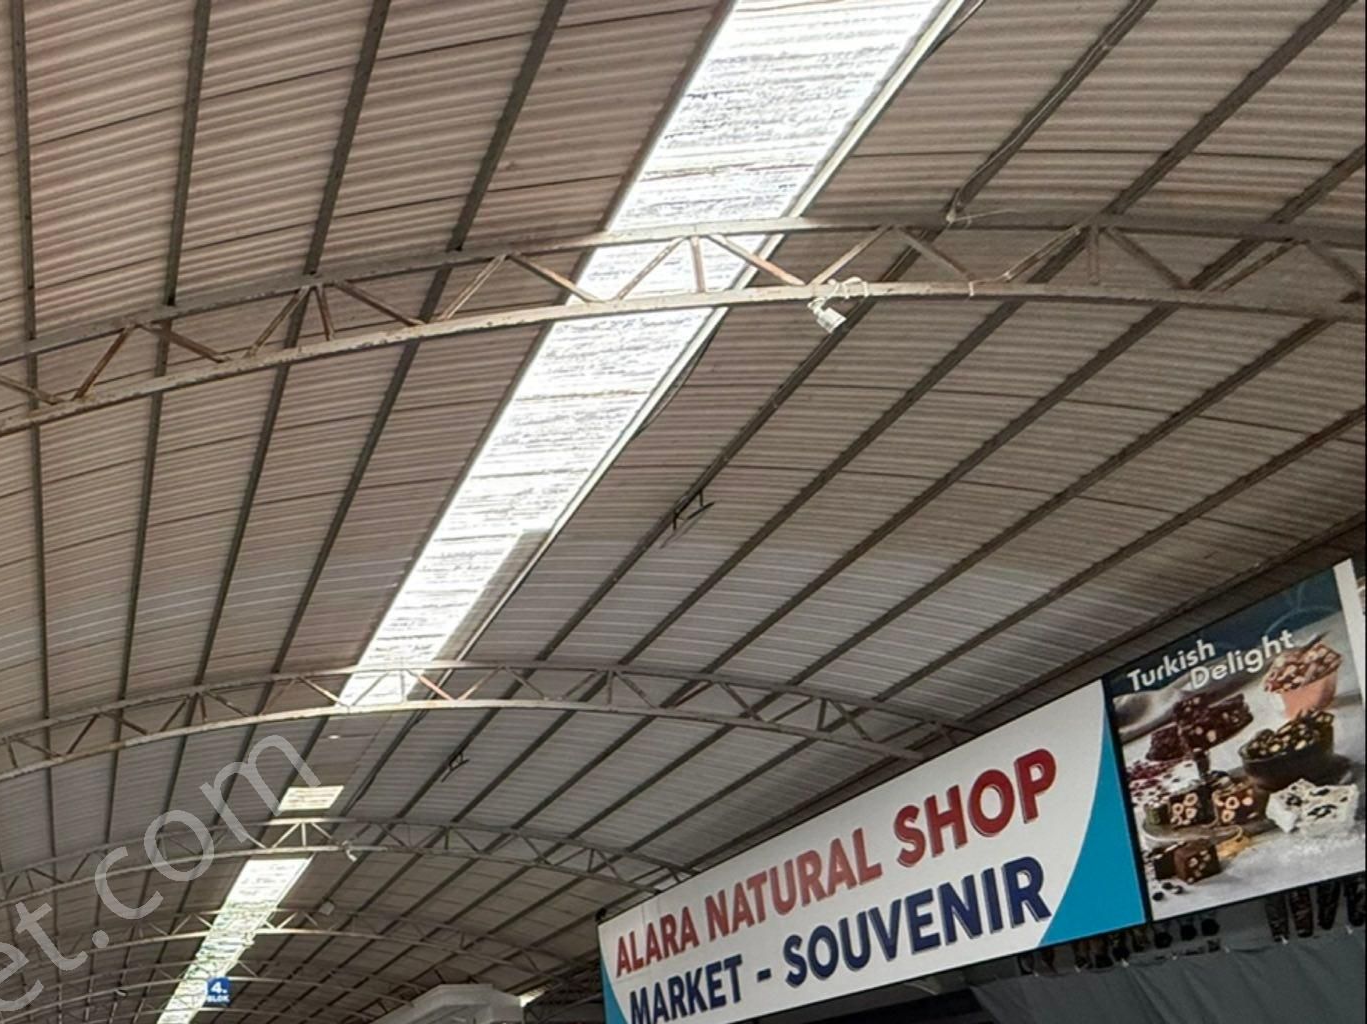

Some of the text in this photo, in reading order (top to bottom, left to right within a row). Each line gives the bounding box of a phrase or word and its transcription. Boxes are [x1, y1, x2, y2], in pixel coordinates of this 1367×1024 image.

[1127, 639, 1216, 692] Turkish
[1190, 629, 1294, 690] Delight
[616, 748, 1057, 978] ALARA NATURAL SHOP
[783, 856, 1052, 988] SOUVENIR
